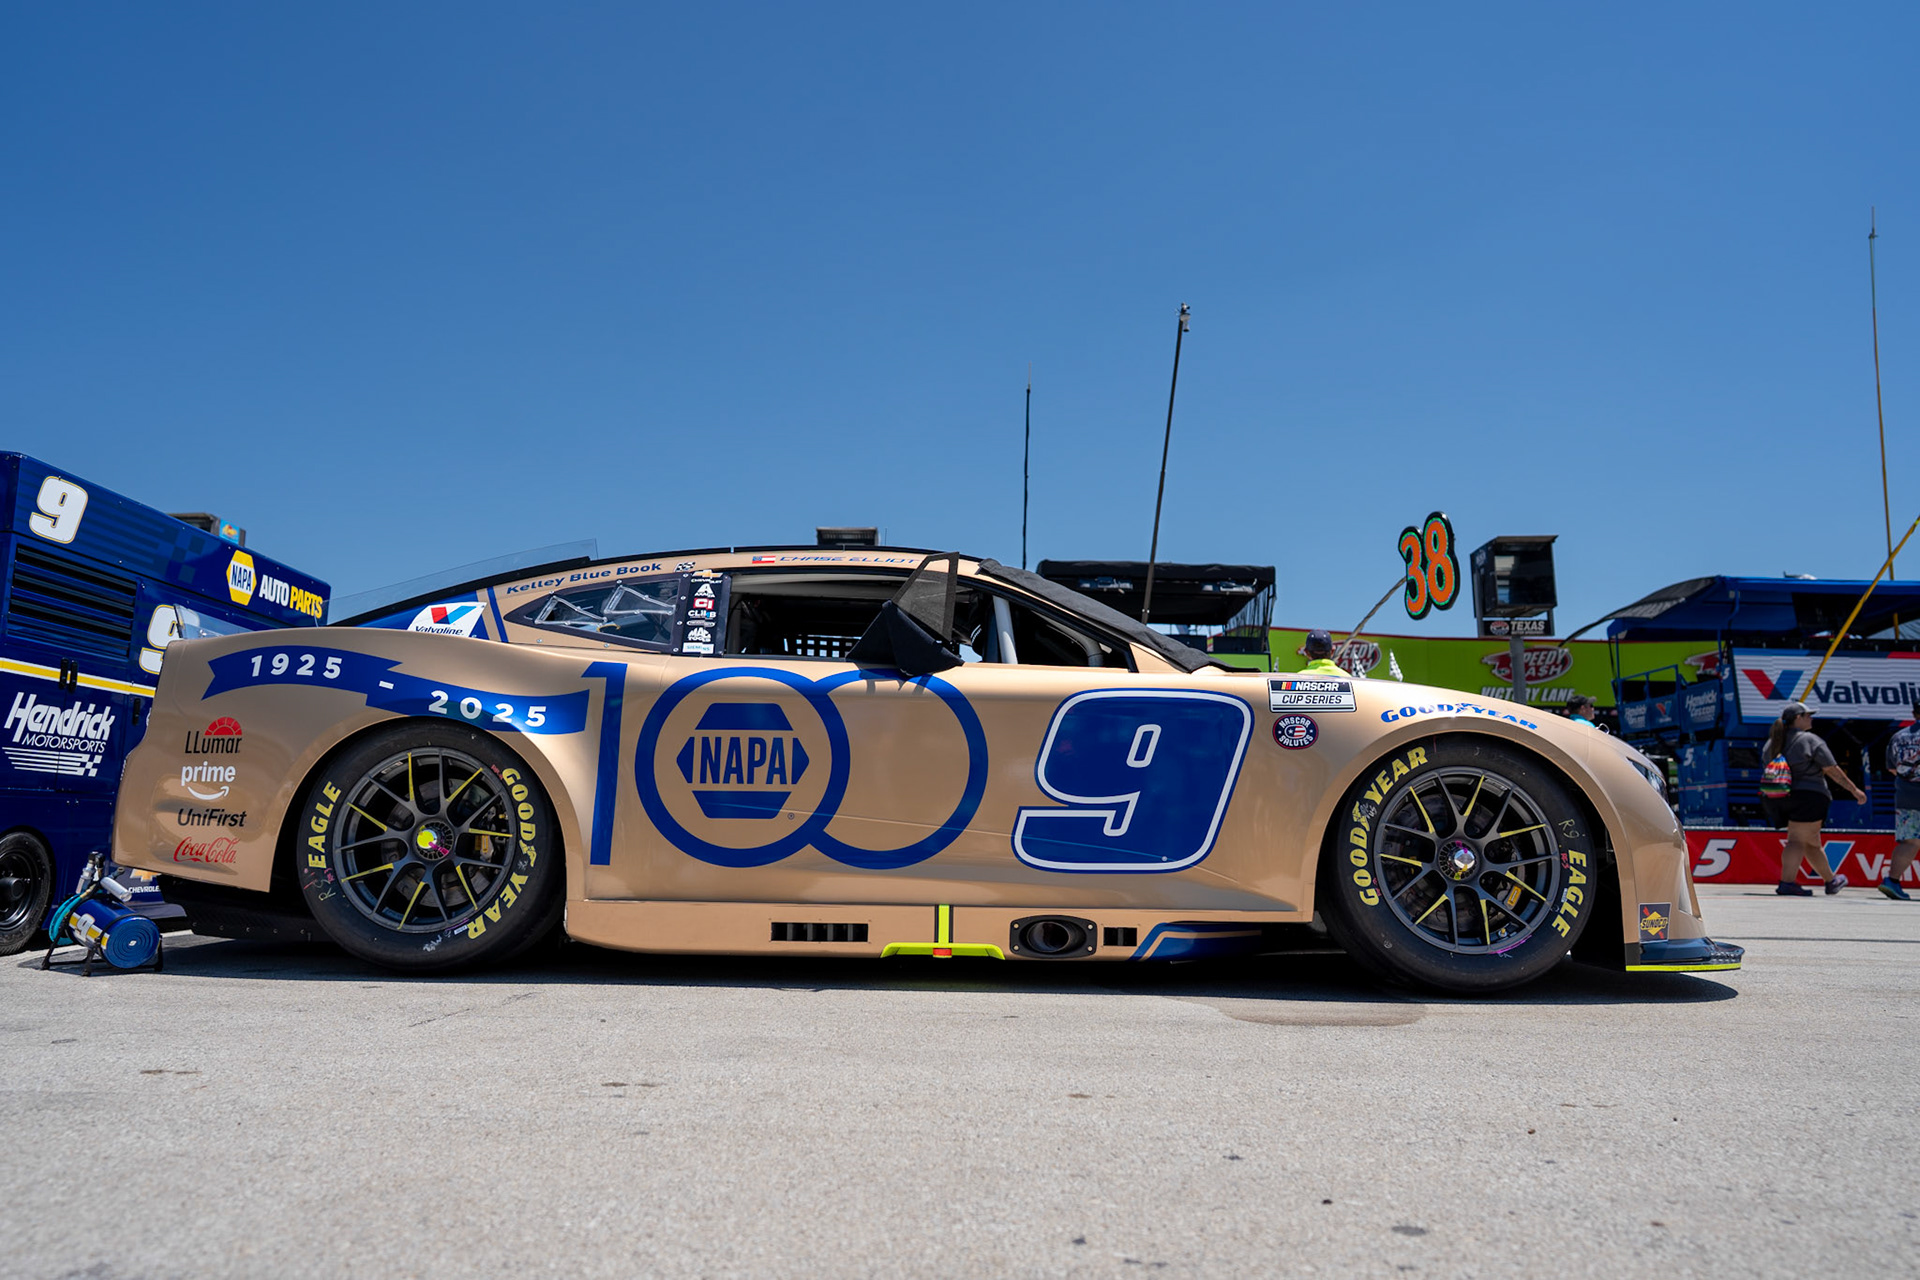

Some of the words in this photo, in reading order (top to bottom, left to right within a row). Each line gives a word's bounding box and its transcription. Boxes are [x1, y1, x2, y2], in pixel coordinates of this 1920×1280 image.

[30, 476, 88, 544] 9
[506, 577, 565, 595] Kelley
[569, 569, 614, 583] Blue
[616, 562, 663, 577] Book
[1400, 516, 1458, 617] 38
[231, 564, 252, 594] NAPA
[258, 574, 290, 607] AUTO
[288, 585, 323, 620] PARTS
[415, 626, 463, 635] Valvoline
[1510, 620, 1545, 631] TEXAS
[139, 604, 200, 674] 9
[1523, 649, 1568, 666] PEEDY
[1525, 664, 1564, 677] ASH
[250, 652, 343, 679] 1925
[428, 690, 548, 728] 2025
[1296, 681, 1340, 692] NASCAR
[1481, 686, 1541, 702] VICTRY
[1281, 694, 1305, 704] CUP
[1305, 694, 1343, 704] SERIES
[4, 691, 116, 744] Hendrick
[1278, 716, 1312, 729] NASCAR
[21, 732, 107, 754] MOTORSPORTS
[184, 731, 243, 754] LLumar
[1278, 735, 1314, 747] SALUTES
[700, 736, 788, 785] NAPA
[181, 761, 236, 787] prime
[1011, 688, 1255, 874] 9
[177, 808, 248, 827] UniFirst
[308, 781, 342, 869] EAGLE
[173, 836, 240, 864] Coca-Cola
[1693, 838, 1737, 878] 5
[128, 885, 160, 894] CHEVROLE
[1551, 849, 1588, 938] EAGLE
[1640, 918, 1668, 929] SUNOCO
